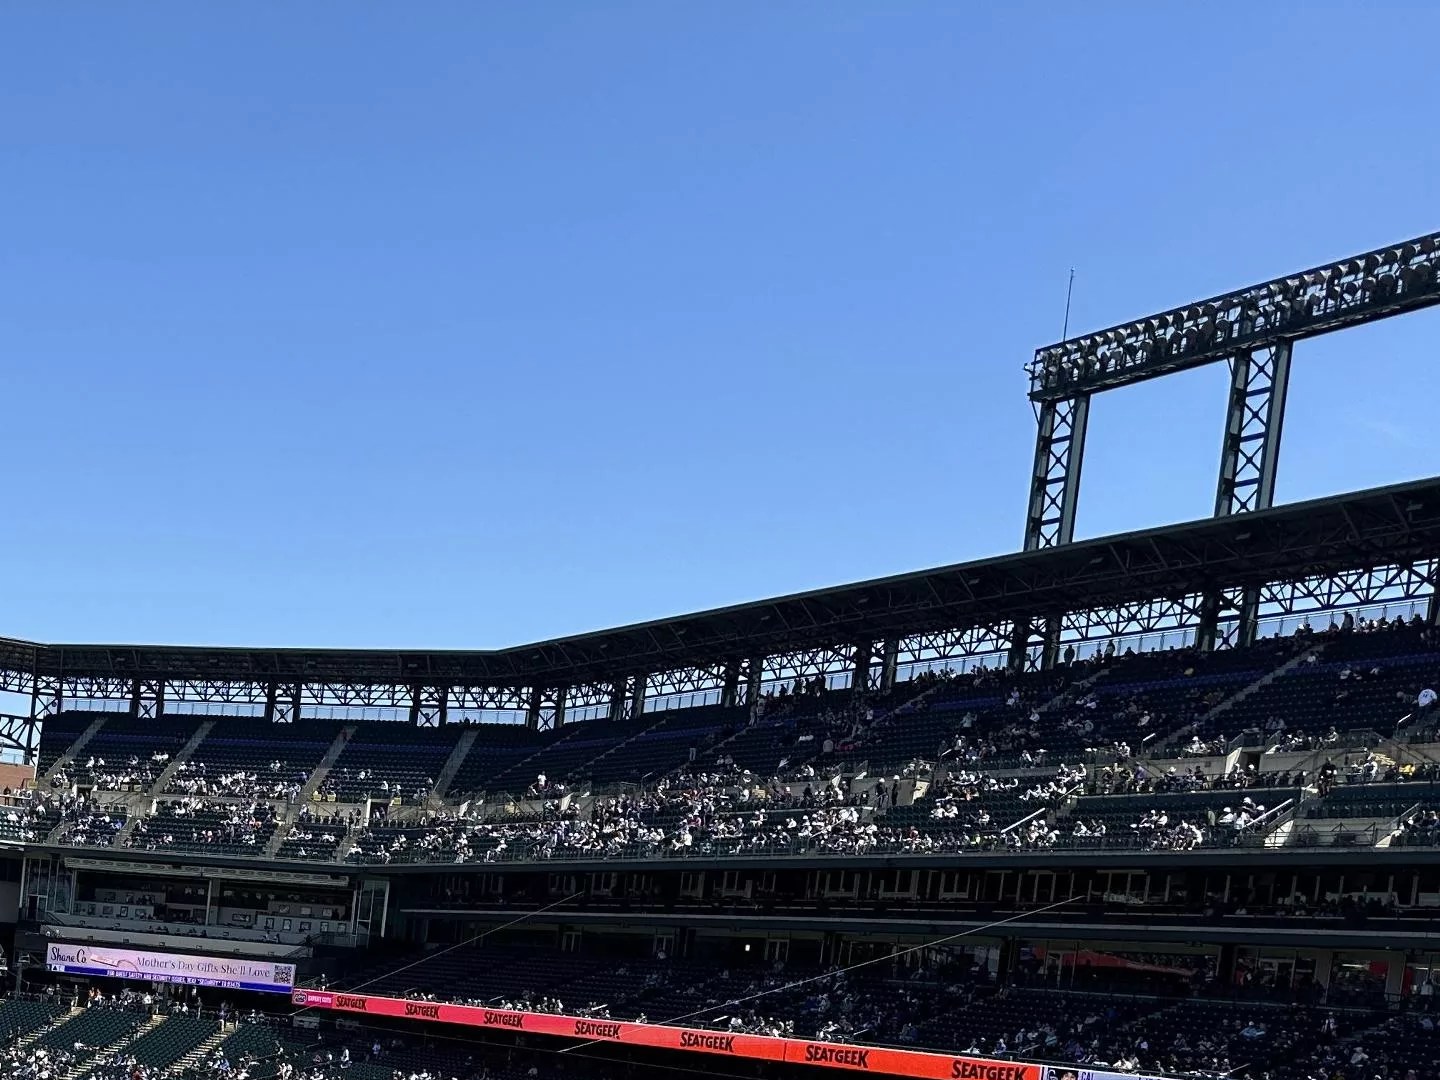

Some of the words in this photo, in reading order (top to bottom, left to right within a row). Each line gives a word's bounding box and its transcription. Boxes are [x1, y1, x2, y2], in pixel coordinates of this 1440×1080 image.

[50, 946, 75, 963] Shane
[137, 956, 176, 970] Mother's
[178, 960, 194, 973] Day
[197, 962, 219, 974] Gifts
[220, 964, 246, 976] She'll
[248, 966, 270, 978] Love
[336, 995, 367, 1011] SEATGEEK
[405, 1003, 440, 1019] SEATGEEK
[483, 1011, 524, 1028] SEATGEEK
[574, 1020, 621, 1039] SEATGEEK
[680, 1031, 736, 1053] SEATGEEK
[804, 1044, 869, 1068] SEATGEEK
